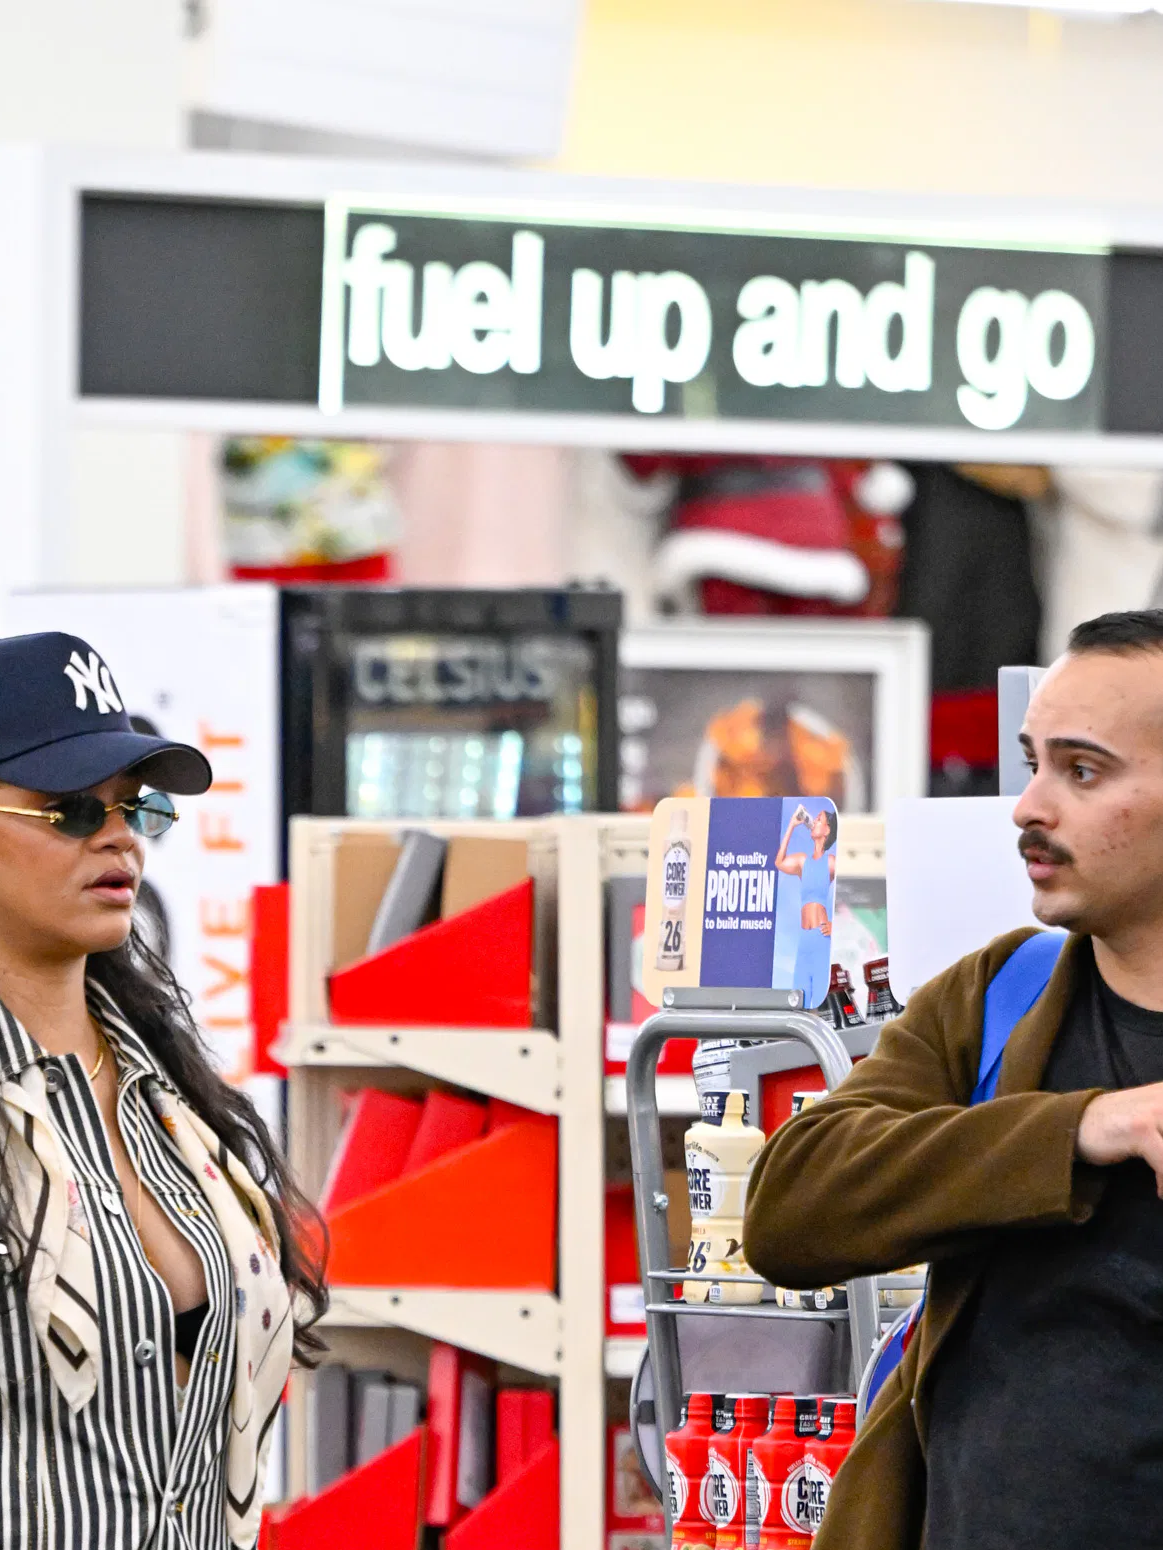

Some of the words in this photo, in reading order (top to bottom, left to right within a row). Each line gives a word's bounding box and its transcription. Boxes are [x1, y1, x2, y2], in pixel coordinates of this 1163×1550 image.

[345, 223, 544, 375] fuel
[569, 268, 712, 414] up
[732, 250, 935, 393] and
[955, 285, 1095, 431] go
[64, 651, 123, 714] NY
[715, 851, 735, 868] high
[736, 852, 768, 868] quality
[666, 861, 687, 882] CORE
[664, 881, 686, 897] POWER
[705, 869, 776, 913] PROTEIN
[704, 918, 715, 930] to
[716, 916, 739, 930] build
[740, 917, 773, 931] muscle
[688, 1167, 711, 1192] ORE
[689, 1192, 712, 1211] WER
